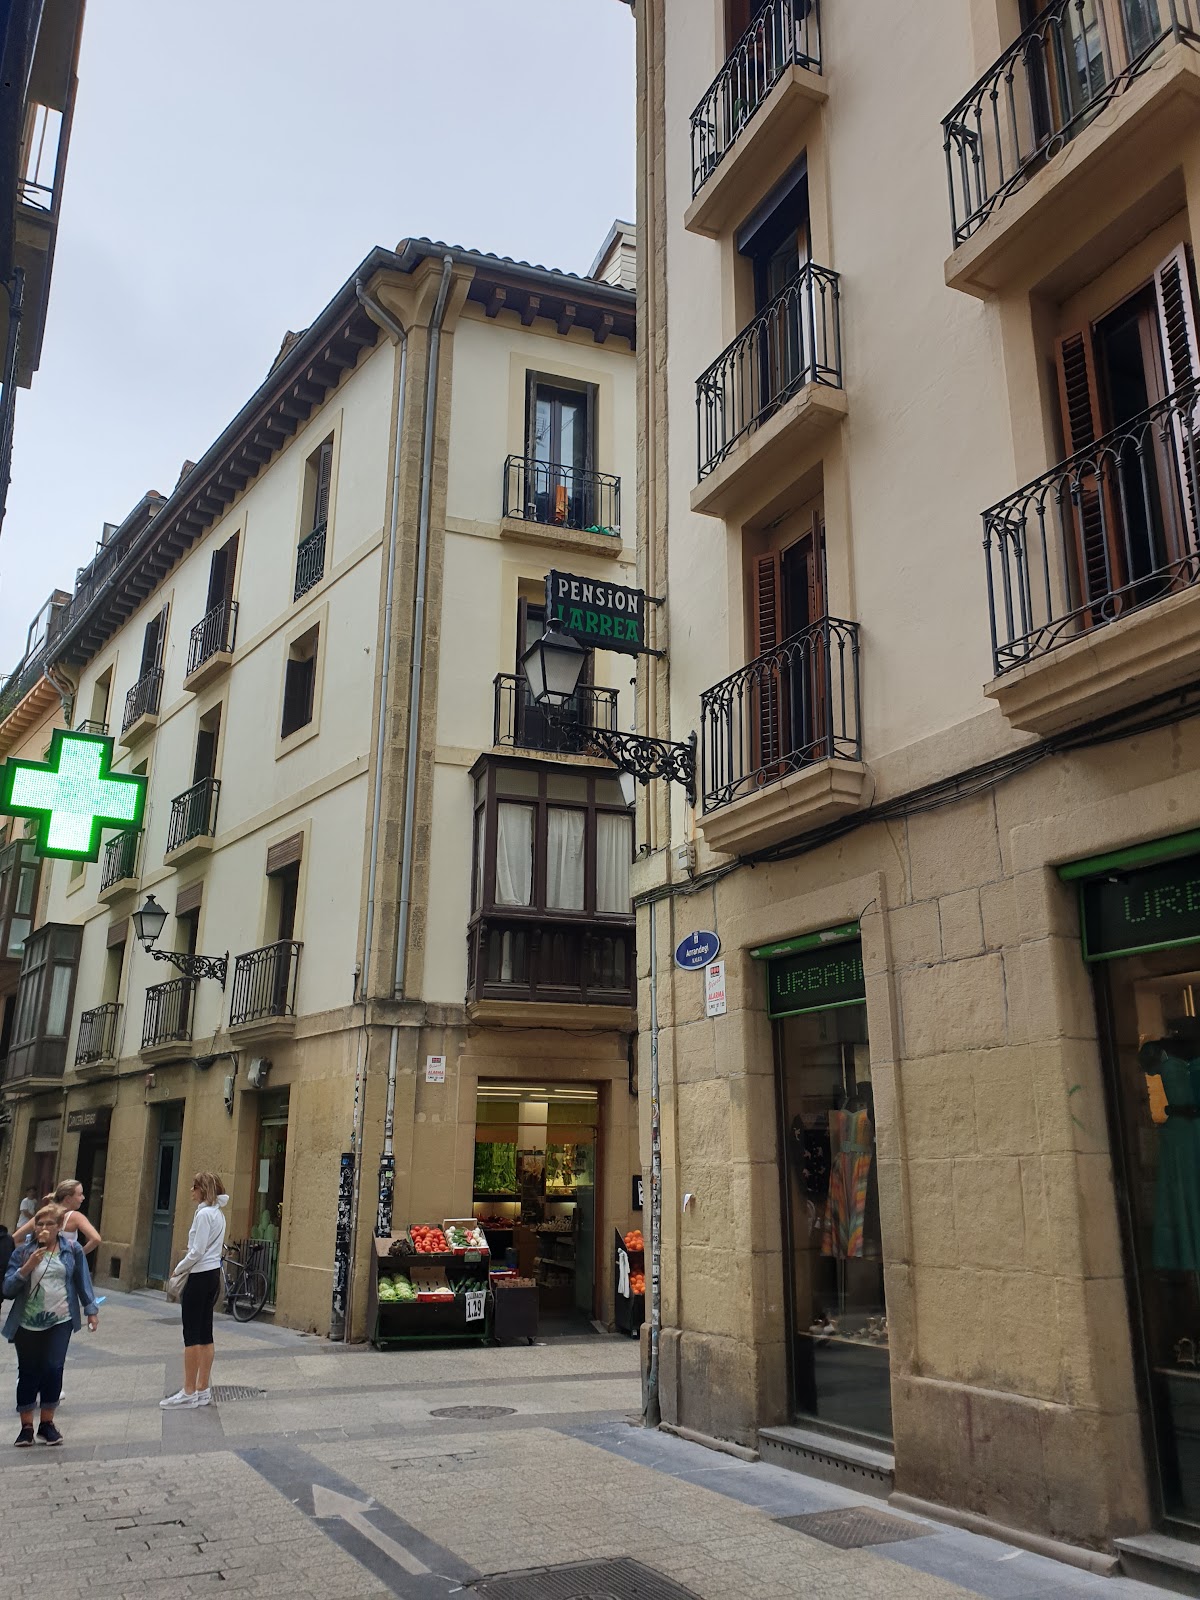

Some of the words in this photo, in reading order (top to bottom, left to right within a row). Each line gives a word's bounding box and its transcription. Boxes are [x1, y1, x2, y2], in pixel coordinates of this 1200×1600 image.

[558, 604, 639, 642] LARREA
[708, 990, 724, 1000] ALARMA
[777, 959, 863, 996] URBAN
